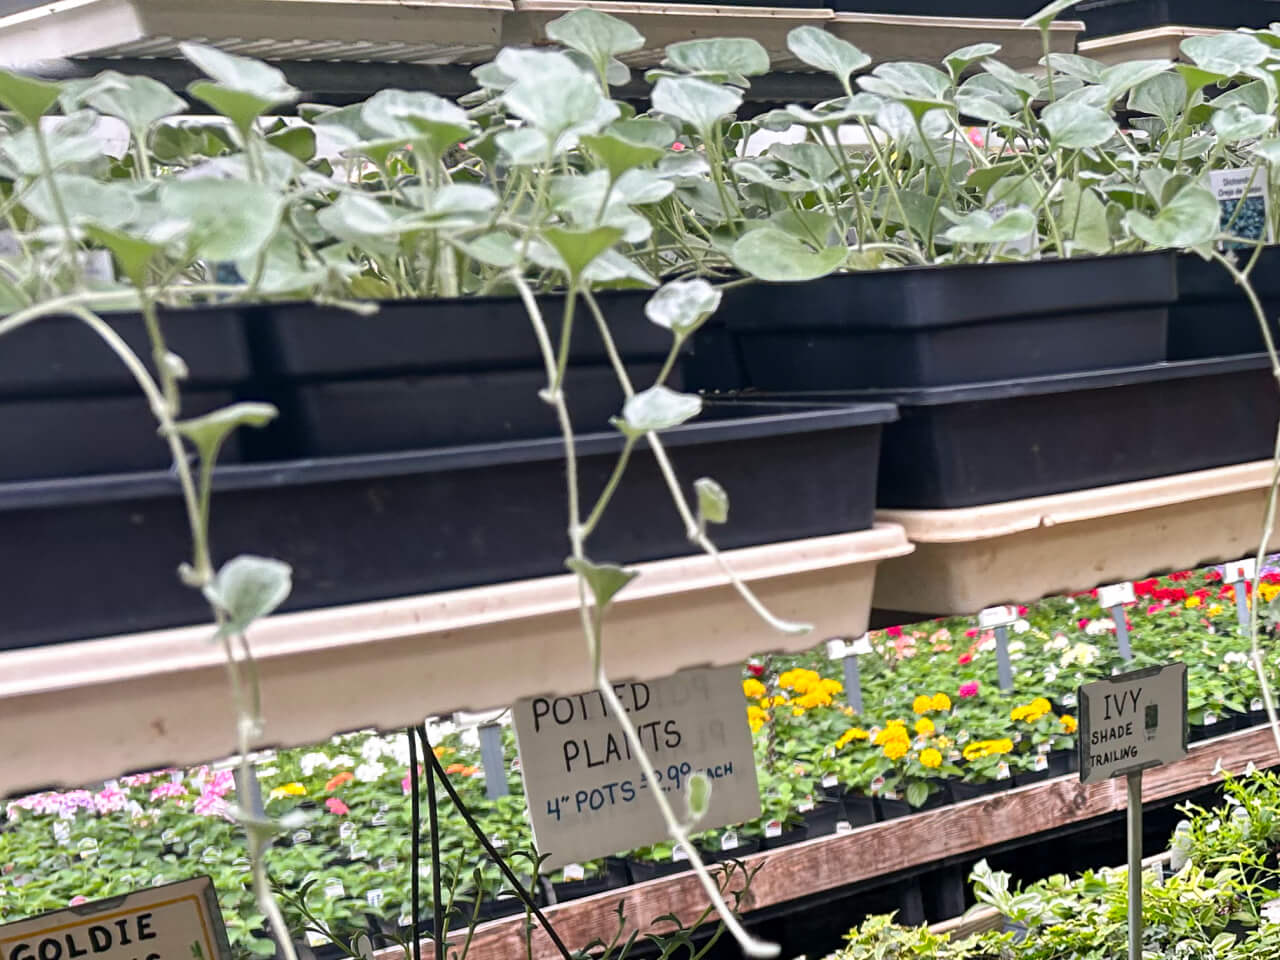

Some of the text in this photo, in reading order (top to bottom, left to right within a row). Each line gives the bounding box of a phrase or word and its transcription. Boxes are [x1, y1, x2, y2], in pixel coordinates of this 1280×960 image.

[1103, 687, 1142, 720] IVY
[1091, 722, 1133, 745] SHADE
[1090, 745, 1138, 767] TRAILING
[575, 780, 636, 813] POTS
